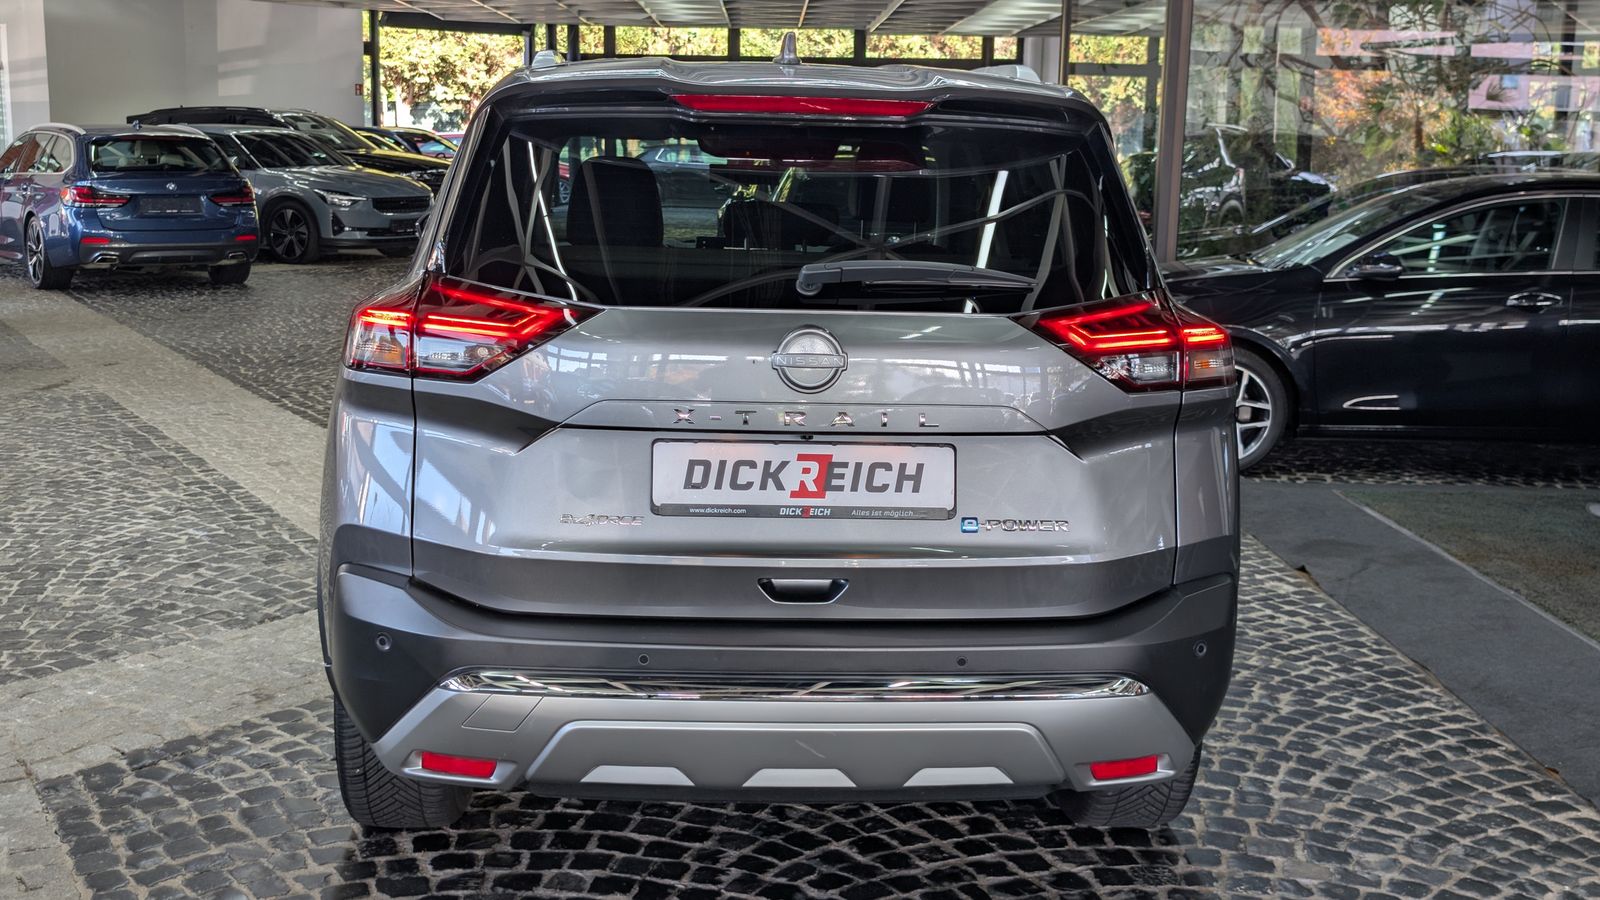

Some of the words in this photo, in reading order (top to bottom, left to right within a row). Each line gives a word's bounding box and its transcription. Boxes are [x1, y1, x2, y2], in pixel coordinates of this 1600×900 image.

[776, 356, 844, 366] NISSAN
[672, 408, 940, 428] X-TRAIL
[683, 453, 925, 499] DICKREICH
[689, 507, 747, 515] www.dickreich.com
[871, 509, 882, 517] ist
[961, 517, 1070, 533] e-POWER
